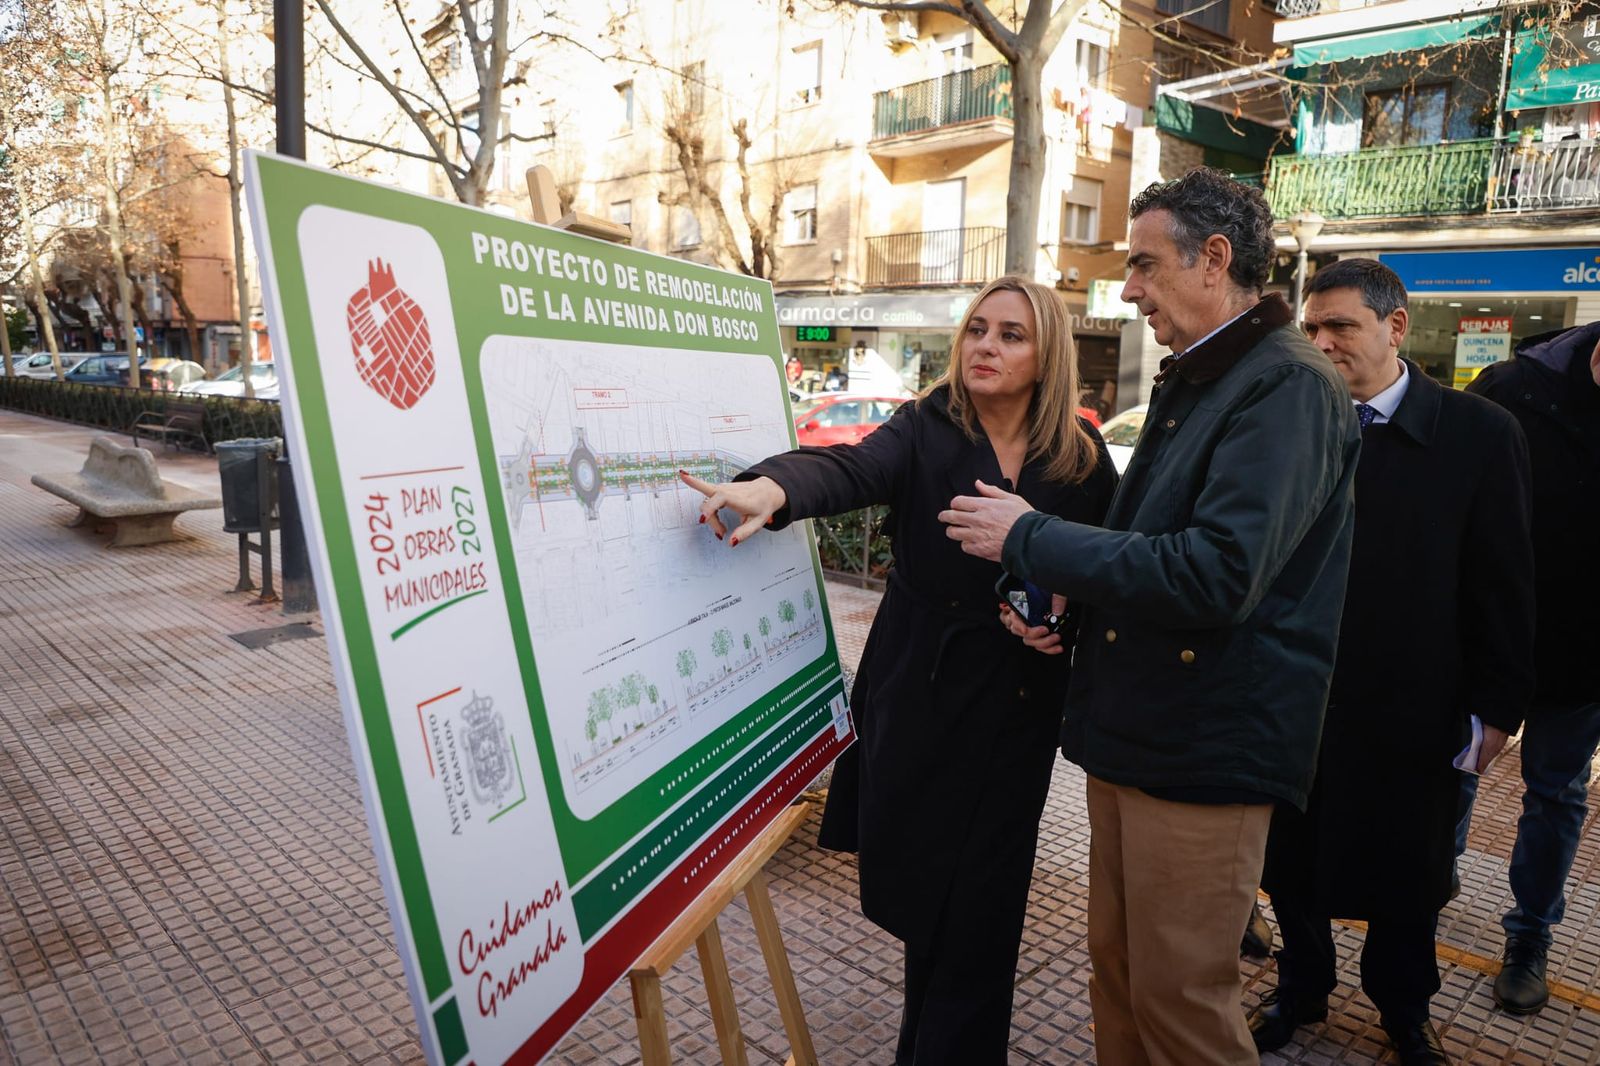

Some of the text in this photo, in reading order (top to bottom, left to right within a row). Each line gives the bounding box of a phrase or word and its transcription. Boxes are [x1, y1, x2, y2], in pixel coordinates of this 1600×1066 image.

[471, 231, 763, 313] PROYECTO DE REMODELACIÓN
[499, 283, 759, 342] DE LA AVENIDA DON BOSCO
[1460, 320, 1509, 331] REBAJAS
[1463, 338, 1504, 346] QUINCENA
[1466, 355, 1498, 363] HOGAR
[400, 485, 442, 518] PLAN
[452, 485, 481, 556] 2027
[364, 490, 401, 576] 2024
[404, 525, 457, 560] OBRAS
[384, 562, 487, 612] MUNICIPALES
[429, 713, 463, 836] AYUNTAMIENTO
[443, 719, 472, 821] DE GRANADA
[478, 919, 567, 1018] Granada
